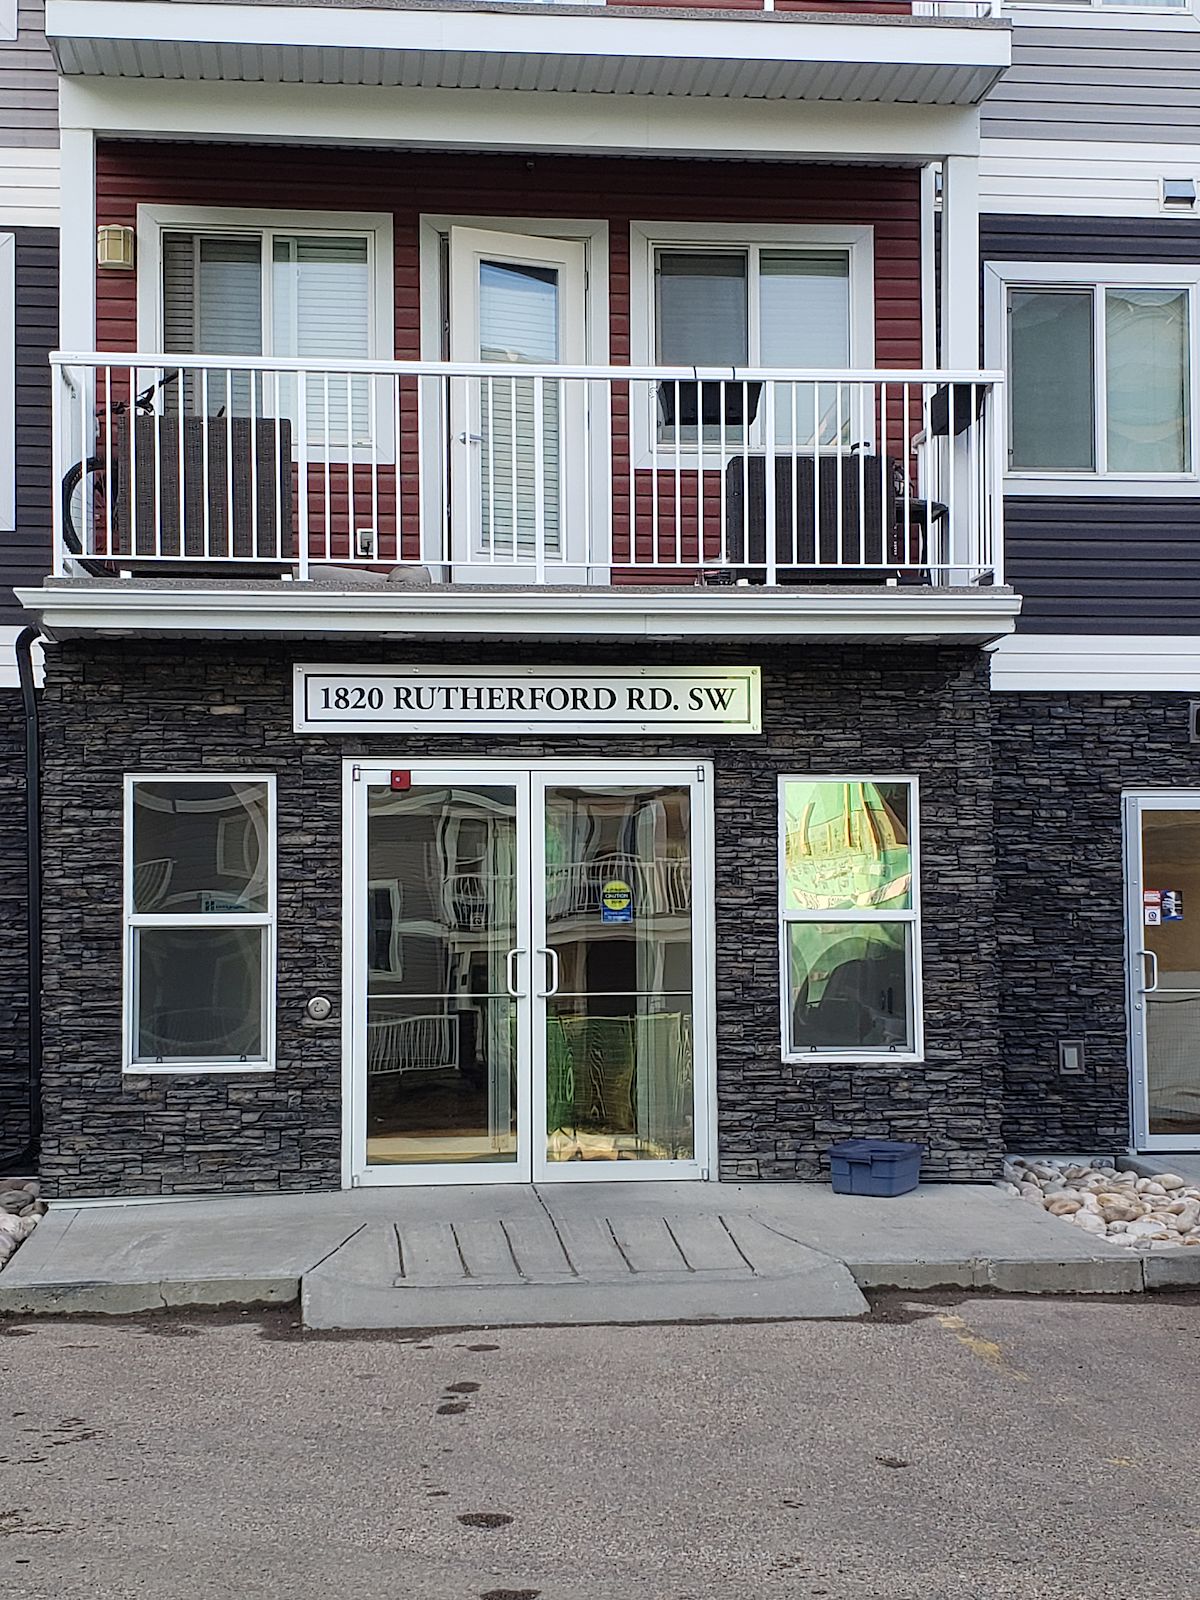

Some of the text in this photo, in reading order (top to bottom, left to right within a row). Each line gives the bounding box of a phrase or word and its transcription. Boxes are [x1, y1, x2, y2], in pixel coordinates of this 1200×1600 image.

[320, 686, 737, 711] 1820 RUTHERFORD RD. SW
